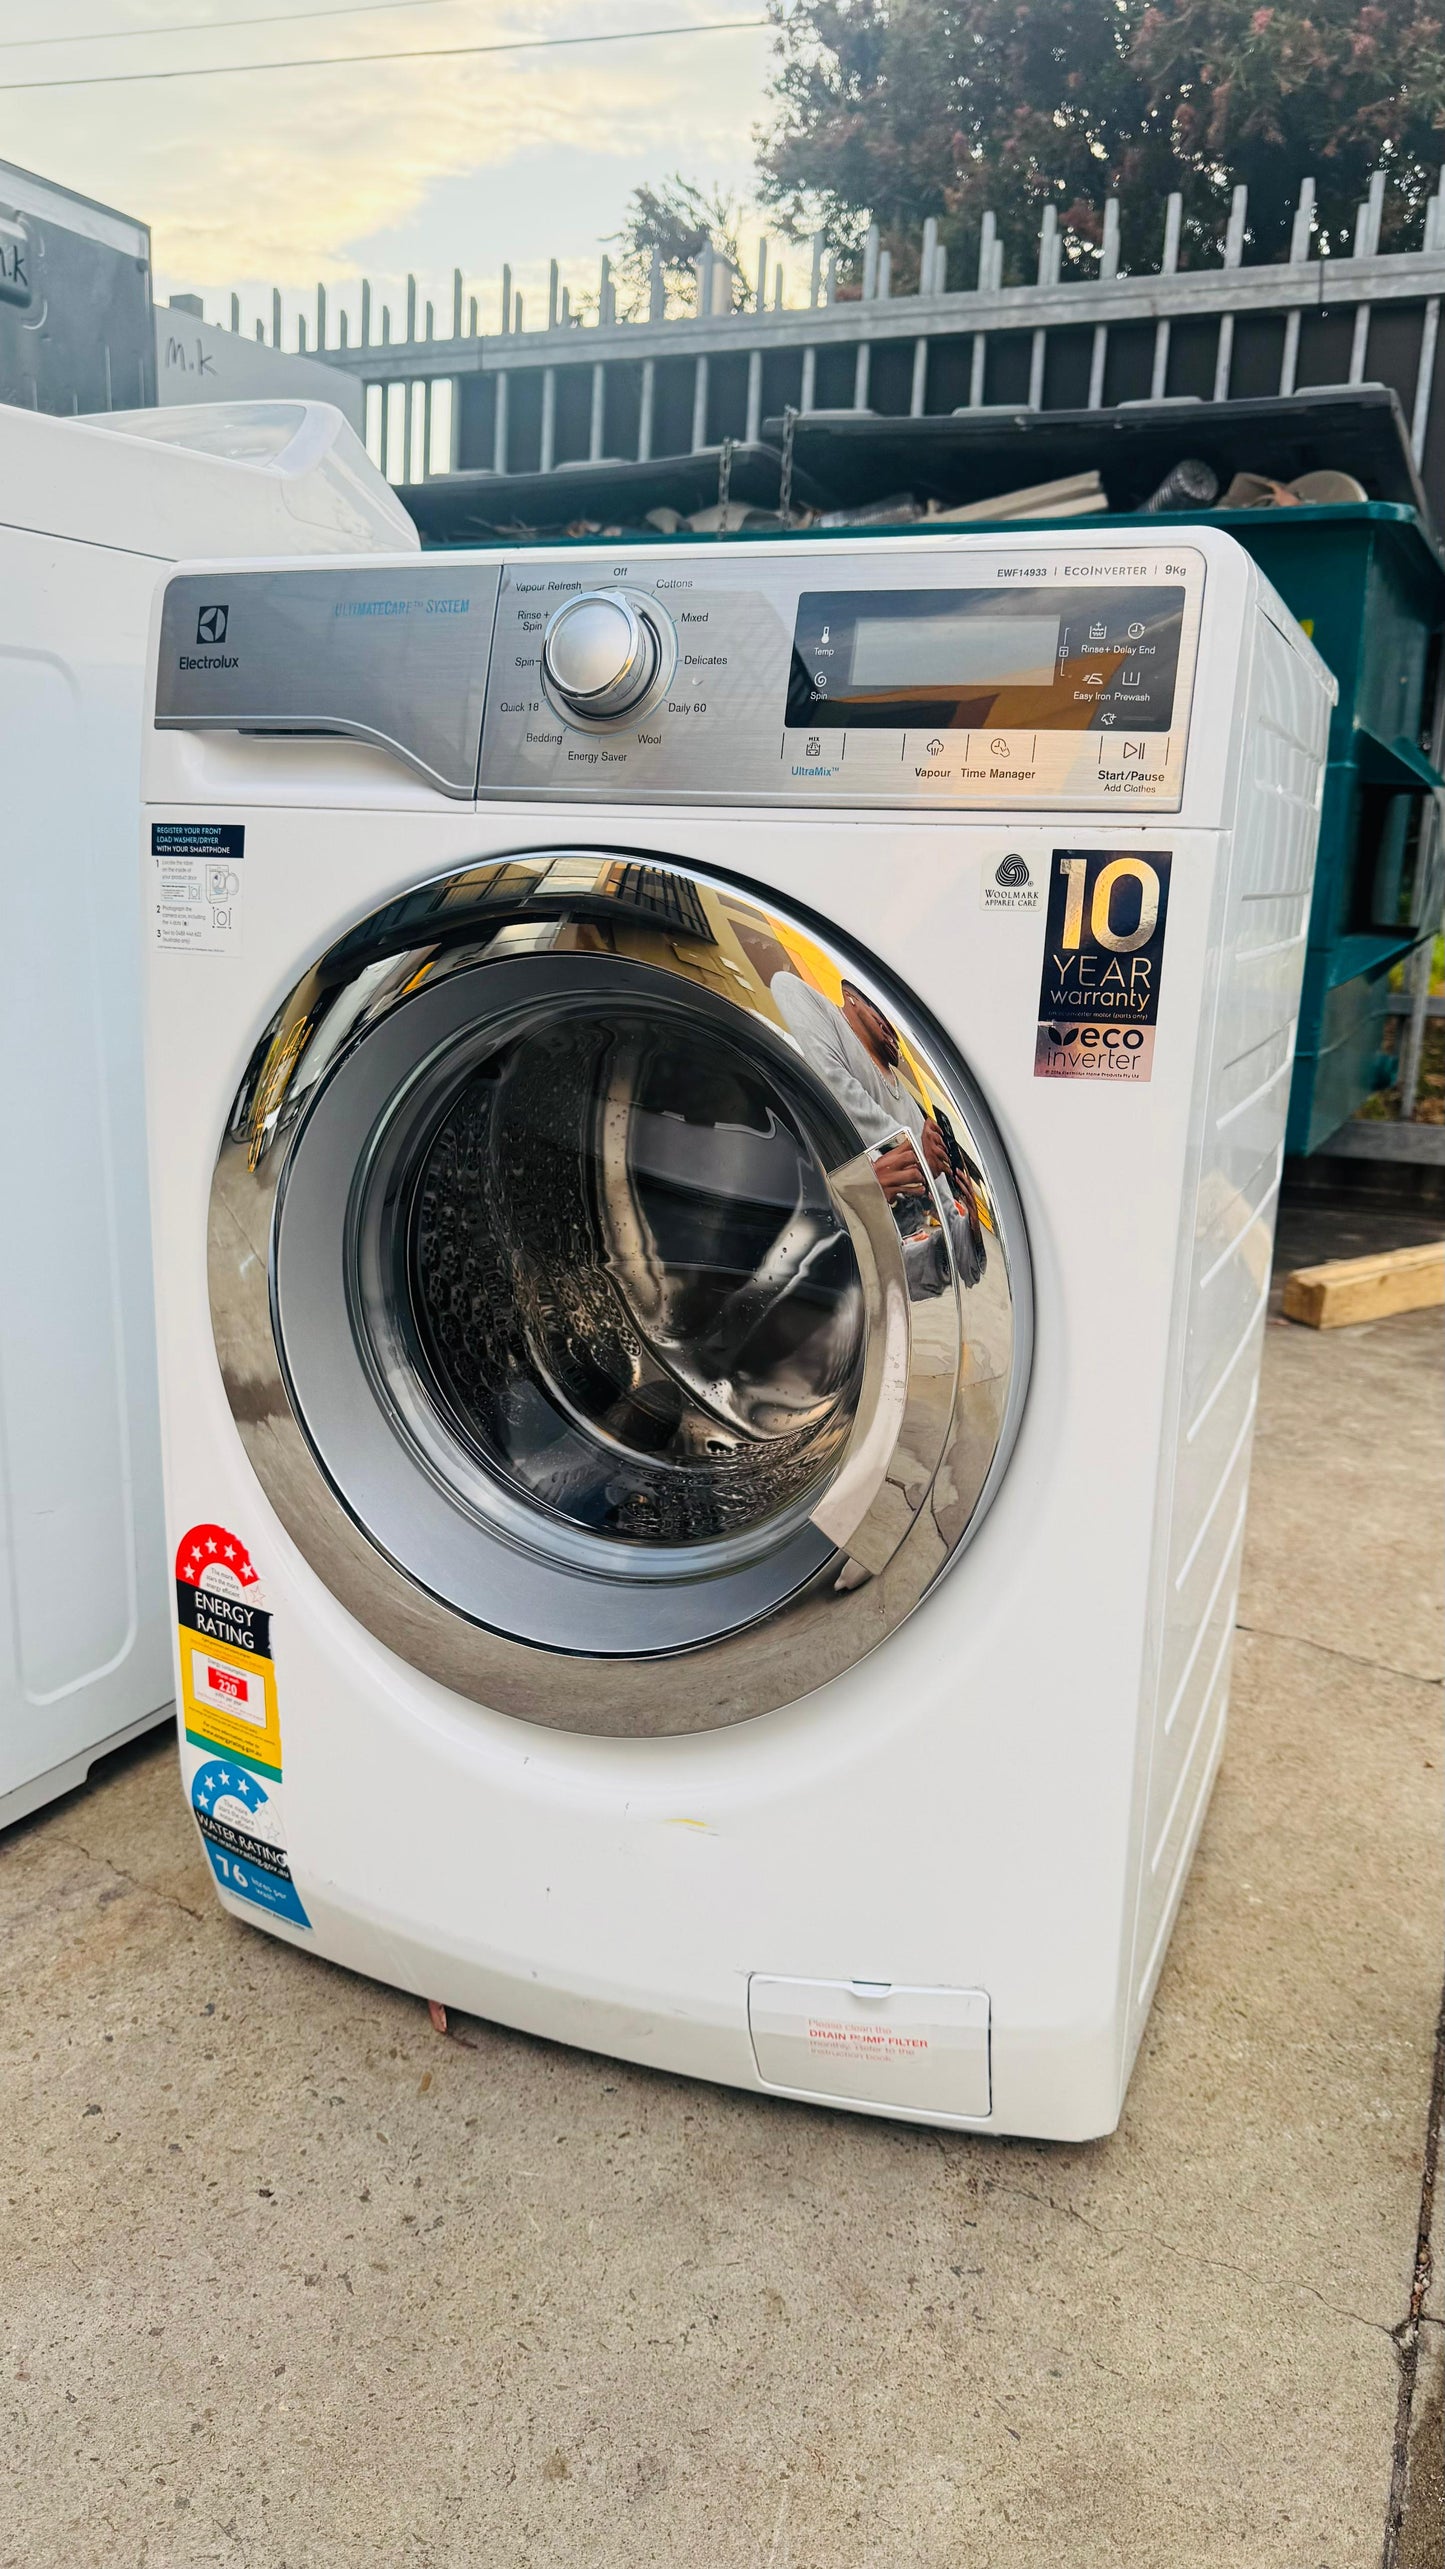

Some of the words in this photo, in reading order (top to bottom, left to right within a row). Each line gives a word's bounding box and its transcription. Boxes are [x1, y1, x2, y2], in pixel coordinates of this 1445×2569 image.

[613, 567, 627, 577] Off
[997, 568, 1047, 577] EWF14933
[515, 582, 545, 593] Vapour
[548, 581, 582, 590] Refresh
[656, 579, 693, 589] Cottons
[426, 599, 470, 613] SYSTEM
[517, 610, 542, 620] Rinse
[681, 612, 709, 622] Mixed
[522, 622, 543, 632] Spin
[814, 647, 834, 657] Temp
[1113, 645, 1136, 656] Delay
[1139, 646, 1155, 654] End
[179, 655, 239, 670] Electrolux
[515, 657, 535, 669] Spin
[684, 655, 728, 665] Delicates
[810, 691, 828, 701] Spin
[1073, 691, 1093, 702] Easy
[1095, 692, 1110, 700] Iron
[1114, 692, 1150, 702] Prewash
[500, 702, 525, 713] Quick
[528, 702, 539, 712] 18
[668, 703, 691, 715] Daily
[693, 703, 707, 713] 60
[526, 733, 563, 745] Bedding
[638, 734, 662, 744] Wool
[567, 751, 599, 763] Energy
[601, 752, 627, 762] Saver
[914, 767, 951, 779] Vapour
[961, 768, 986, 778] Time
[989, 769, 1036, 780] Manager
[1097, 770, 1165, 782] Start/Pause
[1103, 784, 1121, 792] Add
[1123, 784, 1156, 793] Clothes
[202, 827, 222, 835] FRONT
[190, 846, 230, 854] SMARTPHONE
[985, 889, 1039, 899] WOOLMARK
[156, 905, 161, 913] 2
[1060, 857, 1160, 953] 10
[156, 929, 161, 938] 3
[1052, 954, 1152, 988] YEAR
[1050, 988, 1150, 1012] warranty
[1080, 1027, 1144, 1050] eco
[1047, 1047, 1141, 1070] inverter
[194, 1591, 254, 1626] ENERGY
[196, 1613, 255, 1649] RATING
[218, 1679, 238, 1696] 220
[196, 1811, 238, 1844] WATER
[215, 1853, 248, 1888] 76
[809, 2029, 846, 2040] DRAIN
[888, 2037, 929, 2048] FILTER
